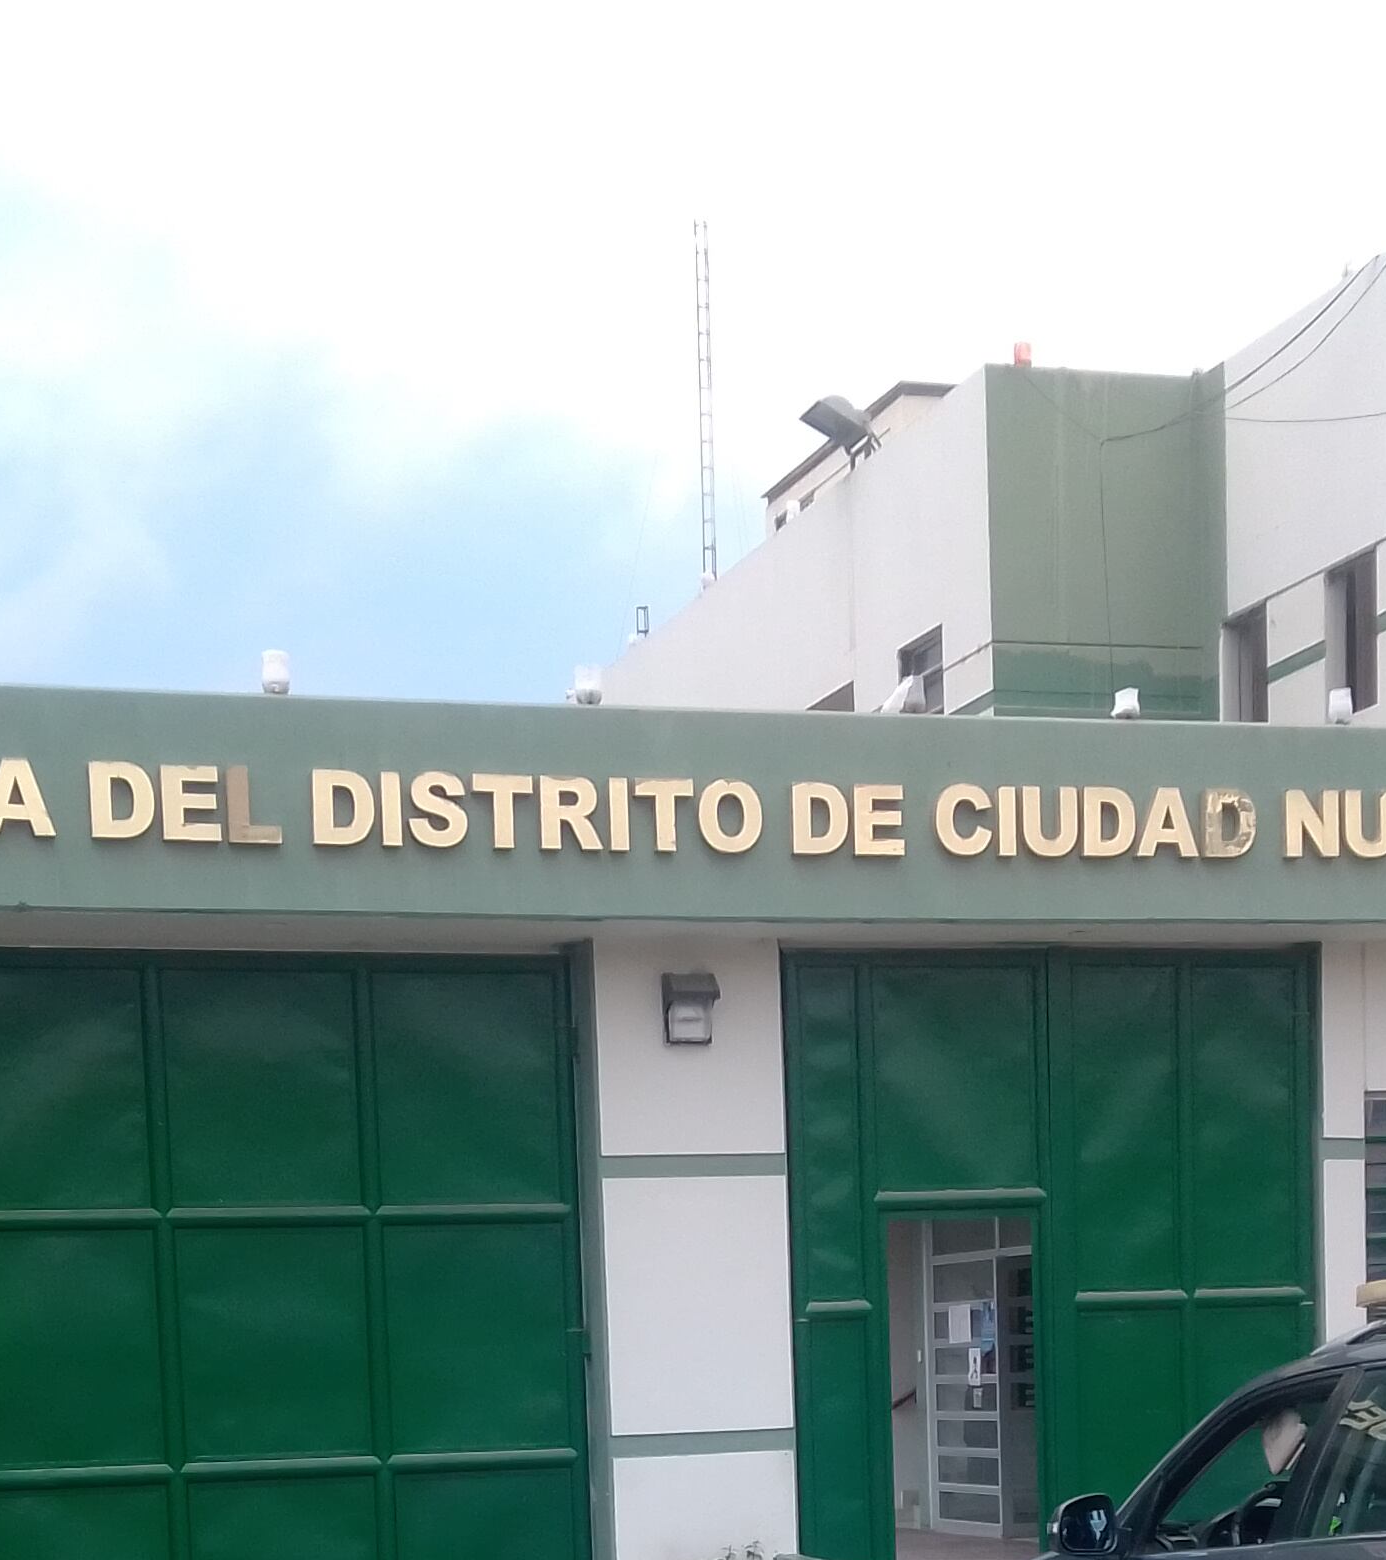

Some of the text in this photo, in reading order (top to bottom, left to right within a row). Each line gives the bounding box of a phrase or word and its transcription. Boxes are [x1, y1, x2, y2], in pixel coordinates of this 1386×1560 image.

[88, 760, 283, 845] DEL
[312, 768, 763, 854] DISTRITO
[791, 781, 906, 857] DE
[935, 783, 1258, 860] CIUDAD
